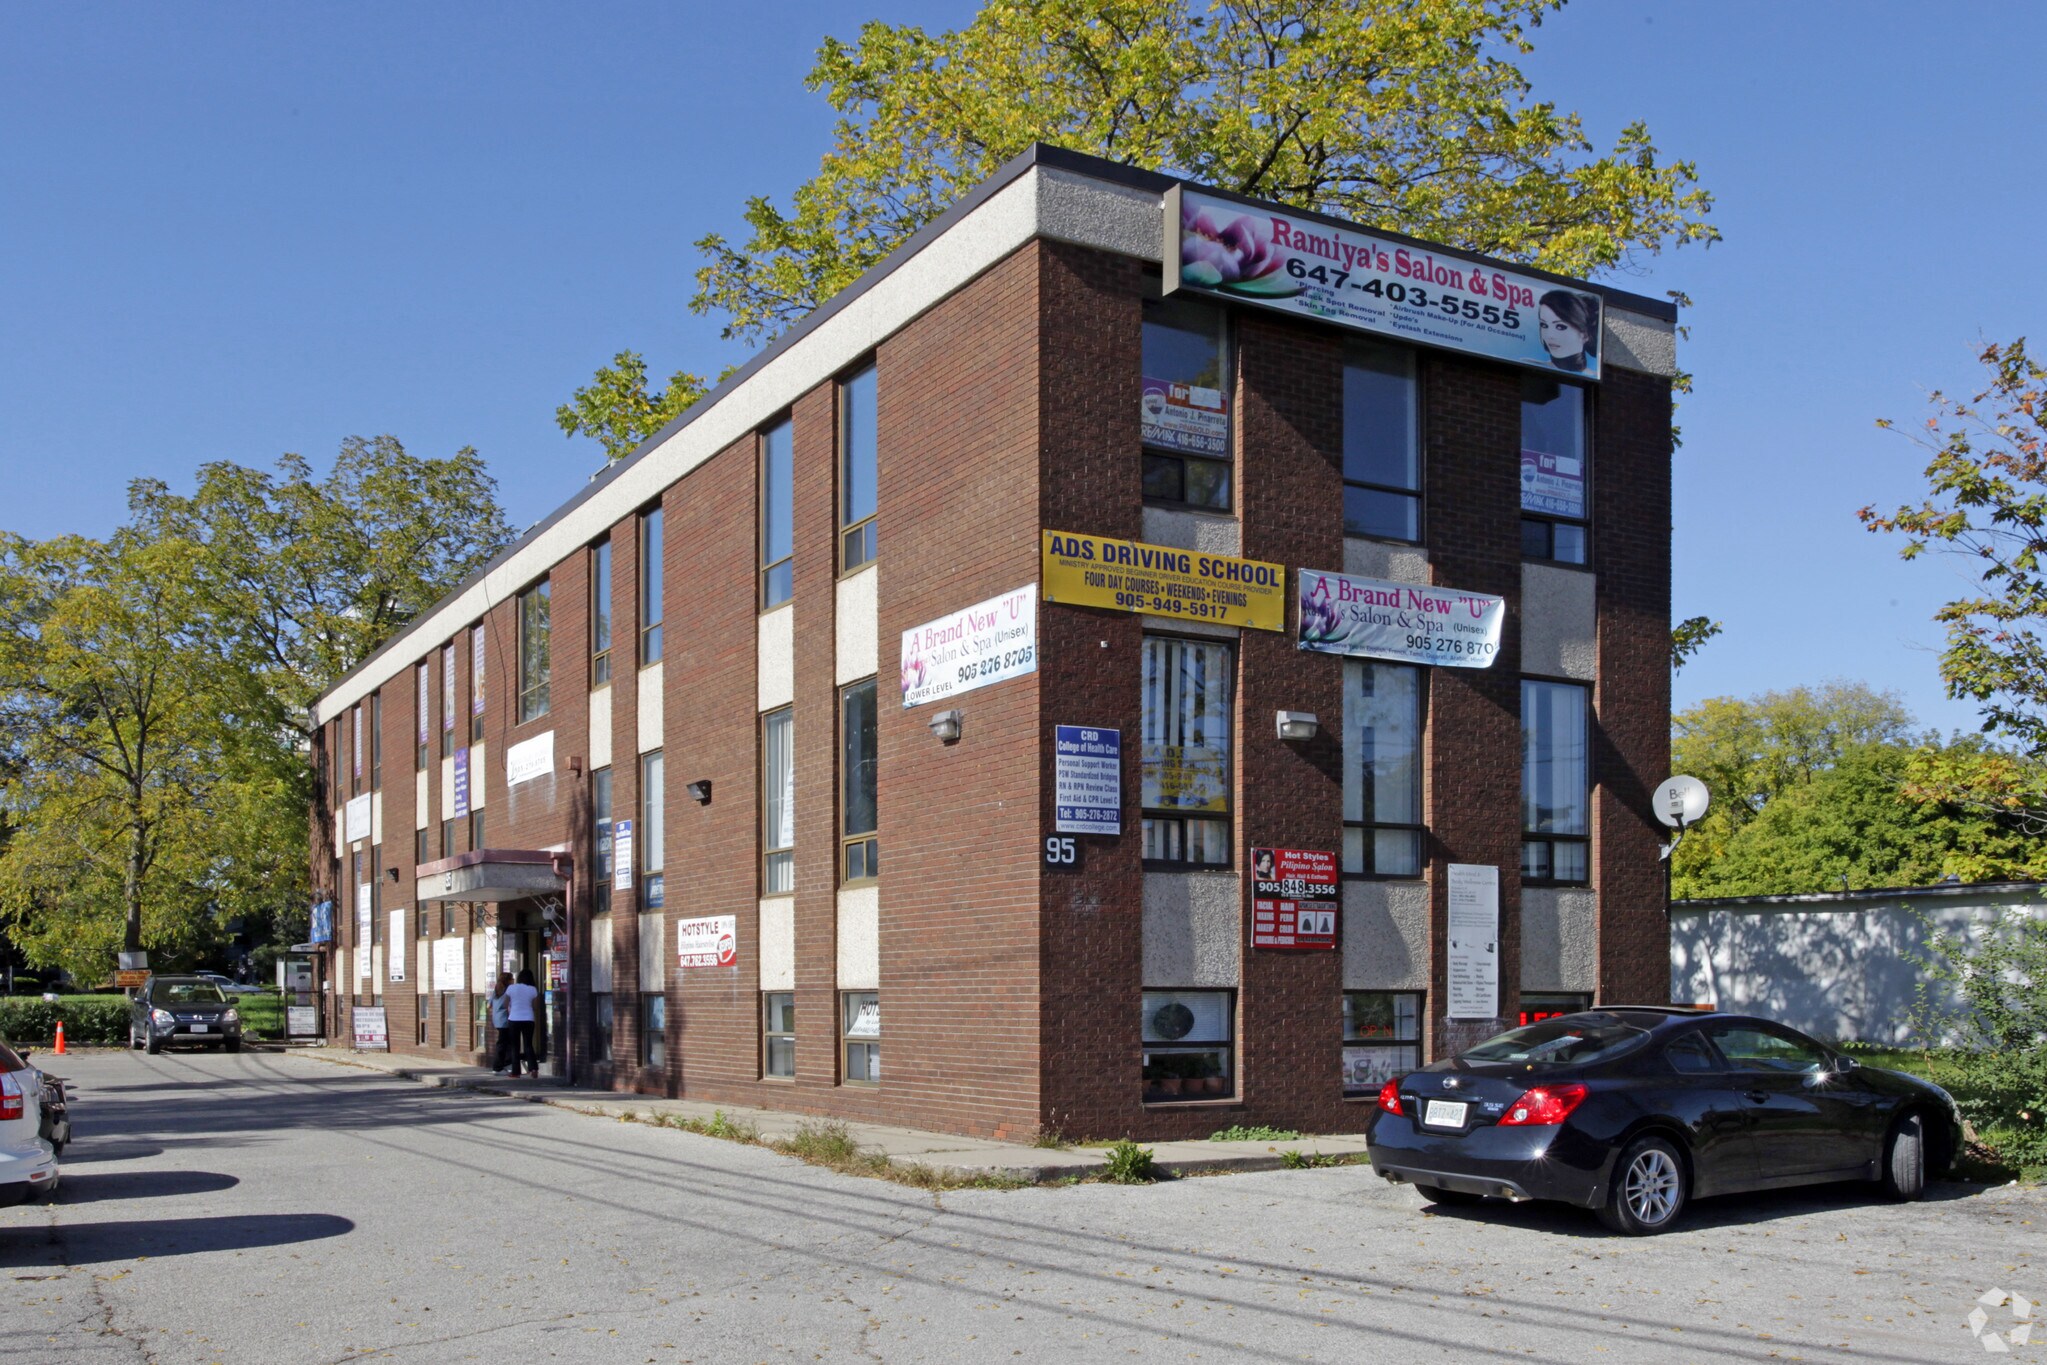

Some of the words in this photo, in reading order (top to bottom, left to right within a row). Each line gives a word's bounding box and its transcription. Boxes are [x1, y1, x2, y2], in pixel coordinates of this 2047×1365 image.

[1270, 217, 1390, 273] Ramiya's
[1395, 248, 1464, 290] Salon
[1469, 268, 1488, 295] &
[1493, 272, 1535, 309] Spa
[1286, 258, 1520, 329] 647-403-5555
[1298, 300, 1318, 312] Skin
[1320, 304, 1336, 316] Tag
[1339, 308, 1376, 323] Removal
[1326, 297, 1346, 309] Spot
[1348, 301, 1385, 317] Removal
[1392, 304, 1424, 317] Airbrush
[1392, 312, 1418, 324] Updo's
[1392, 321, 1422, 334] Eyelash
[1423, 327, 1463, 342] Extensions
[1141, 425, 1175, 442] RE/MAX
[1103, 543, 1190, 574] DRIVING
[1199, 557, 1279, 587] SCHOOL
[1059, 559, 1089, 570] MINISTRY
[1091, 563, 1124, 574] APPROVED
[1126, 567, 1157, 578] BEGINNER
[1159, 571, 1181, 582] DRIVER
[1182, 574, 1216, 586] EDUCATION
[1218, 579, 1242, 590] COURSE
[1243, 583, 1272, 595] PROVIDER
[1085, 571, 1105, 588] FOUR
[1108, 575, 1123, 591] DAY
[1125, 576, 1159, 595] COURSES
[1166, 582, 1206, 601] WEEKENDS
[1212, 589, 1247, 607] EVENINGS
[1310, 576, 1331, 599] A
[1338, 579, 1401, 609] Brand
[1407, 589, 1452, 615] New
[1115, 592, 1228, 619] 905-949-5917
[1350, 605, 1391, 626] Salon
[1397, 611, 1411, 629] &
[1417, 614, 1444, 635] Spa
[1453, 622, 1488, 636] (Unisex)
[910, 632, 920, 655] A
[925, 617, 963, 651] Brand
[967, 610, 998, 635] New
[930, 646, 957, 667] Salon
[960, 639, 970, 657] &
[973, 635, 991, 655] Spa
[994, 622, 1029, 646] (Unisex)
[1406, 635, 1431, 650] 905
[1436, 639, 1462, 653] 276
[958, 663, 978, 683] 905
[980, 655, 1001, 675] 276
[1004, 645, 1033, 669] 8705
[906, 687, 931, 701] LOWER
[932, 681, 953, 695] LEVEL
[1081, 730, 1099, 741] CRD
[1058, 740, 1080, 754] College
[1080, 742, 1086, 752] of
[1087, 742, 1104, 754] Health
[1105, 744, 1117, 755] Care
[1058, 758, 1080, 767] Personal
[1081, 760, 1100, 769] Support
[1101, 761, 1117, 770] Worker
[1070, 770, 1099, 780] Standardized
[1100, 772, 1117, 783] Bridging
[1086, 783, 1103, 792] Review
[1104, 784, 1117, 793] Class
[1669, 787, 1690, 799] Bell
[1059, 793, 1071, 802] First
[1073, 794, 1082, 802] Aid
[1088, 795, 1099, 803] CPR
[1100, 796, 1113, 804] Level
[1060, 807, 1072, 819] Tel:
[1046, 837, 1075, 863] 95
[1303, 852, 1329, 862] Styles
[1280, 861, 1310, 872] Pilipino
[1312, 862, 1333, 871] Salon
[1259, 879, 1336, 895] 905.848.3556
[1280, 902, 1295, 911] HAIR
[682, 921, 719, 936] HOTSTYLE
[1359, 1024, 1393, 1038] OPN
